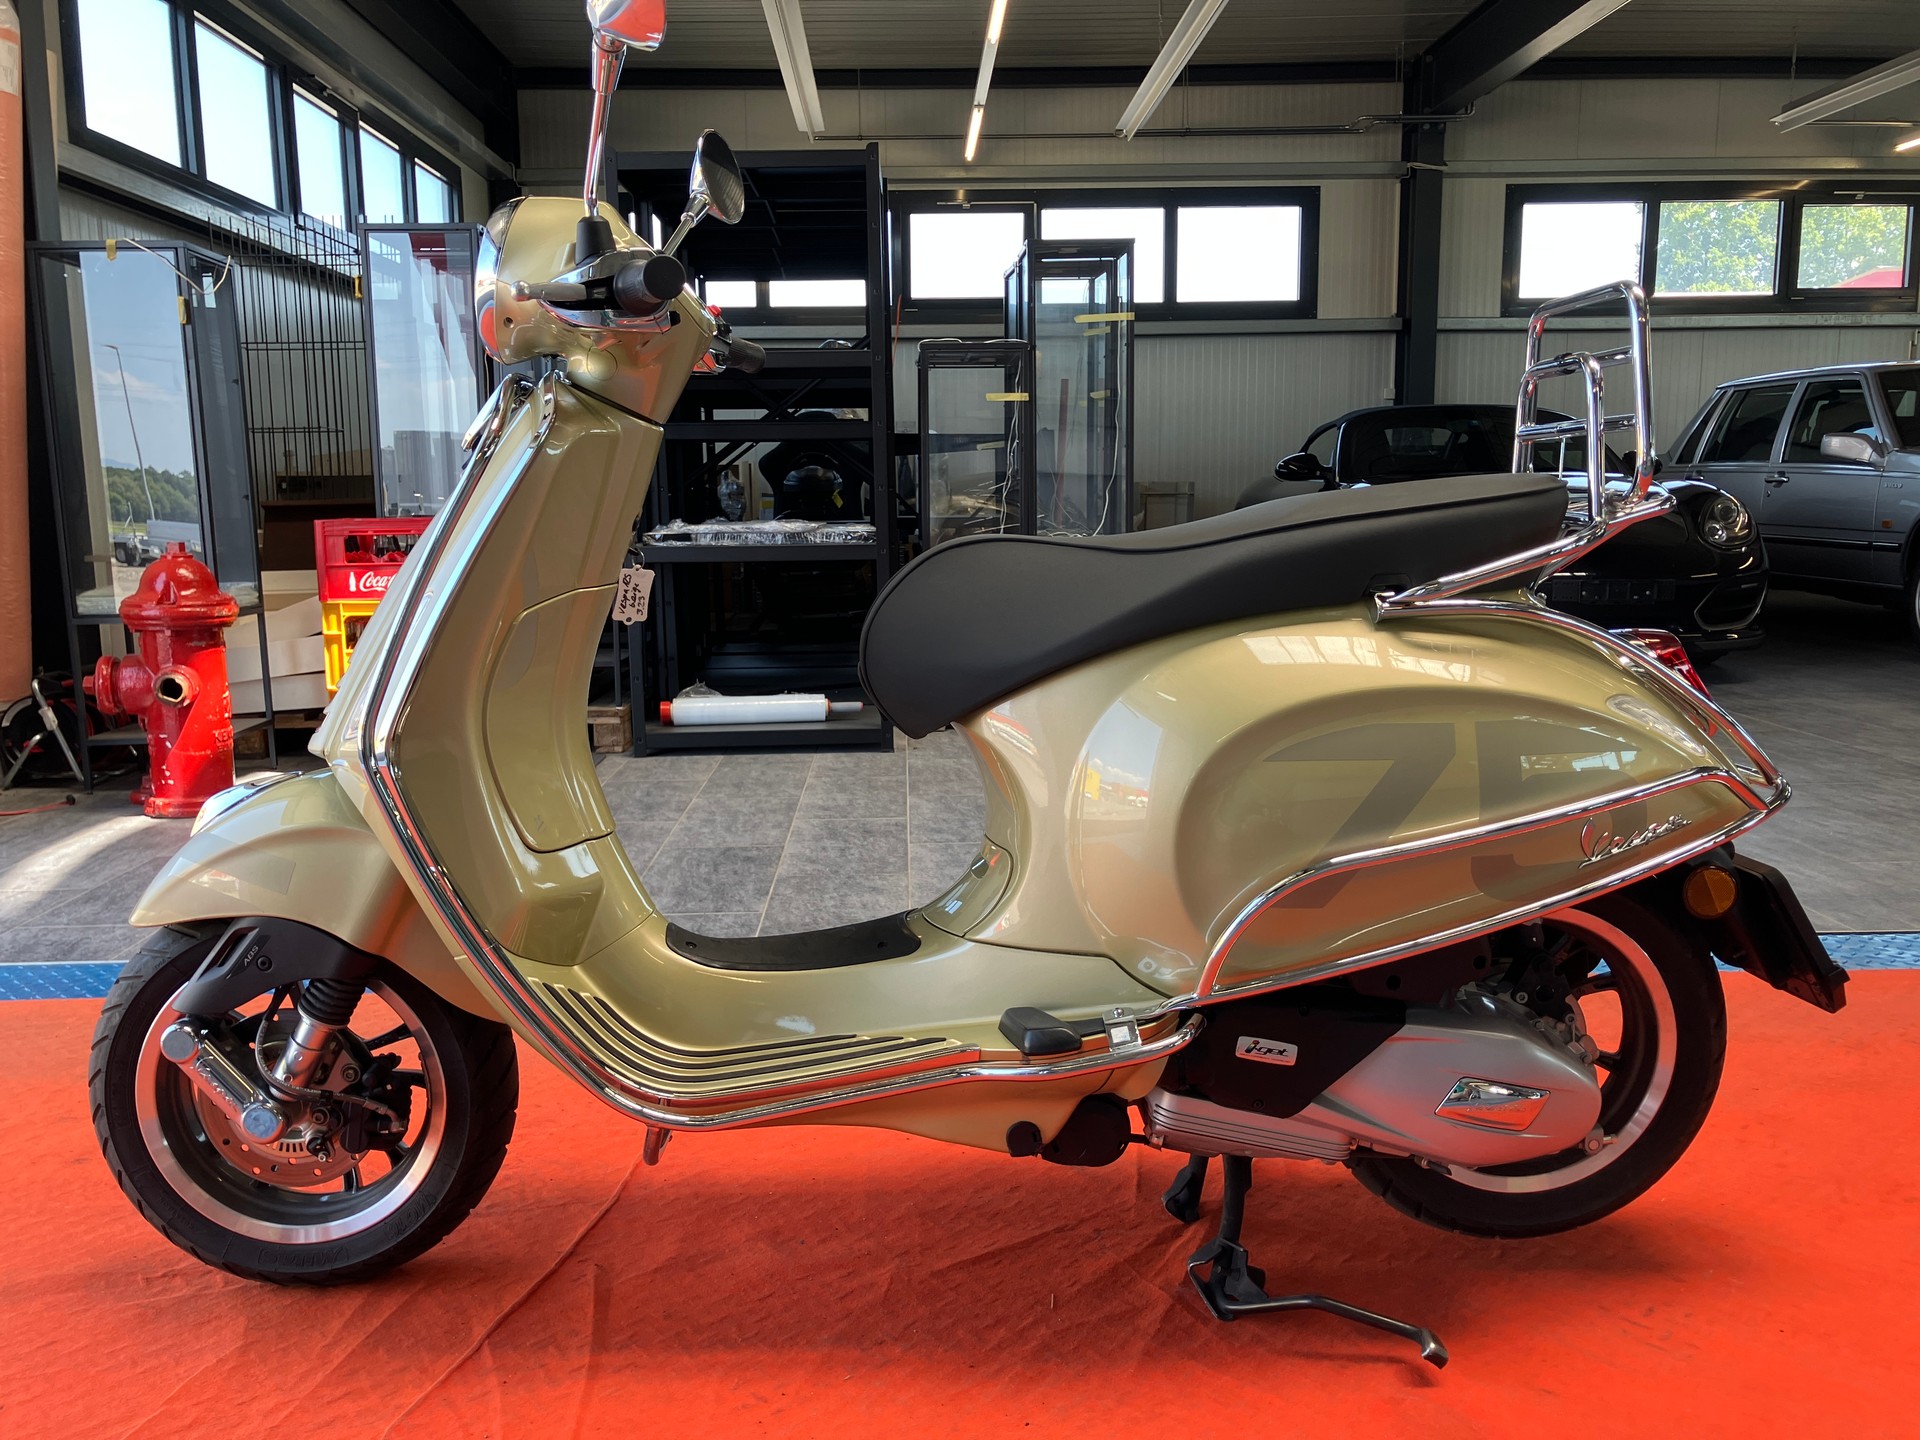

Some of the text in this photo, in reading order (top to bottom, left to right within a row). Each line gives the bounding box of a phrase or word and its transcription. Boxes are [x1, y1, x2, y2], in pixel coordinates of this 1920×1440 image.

[618, 589, 630, 614] Vespa
[629, 583, 641, 608] beige
[1262, 720, 1648, 908] 75
[1578, 815, 1692, 869] Vespa
[243, 944, 260, 967] ABS
